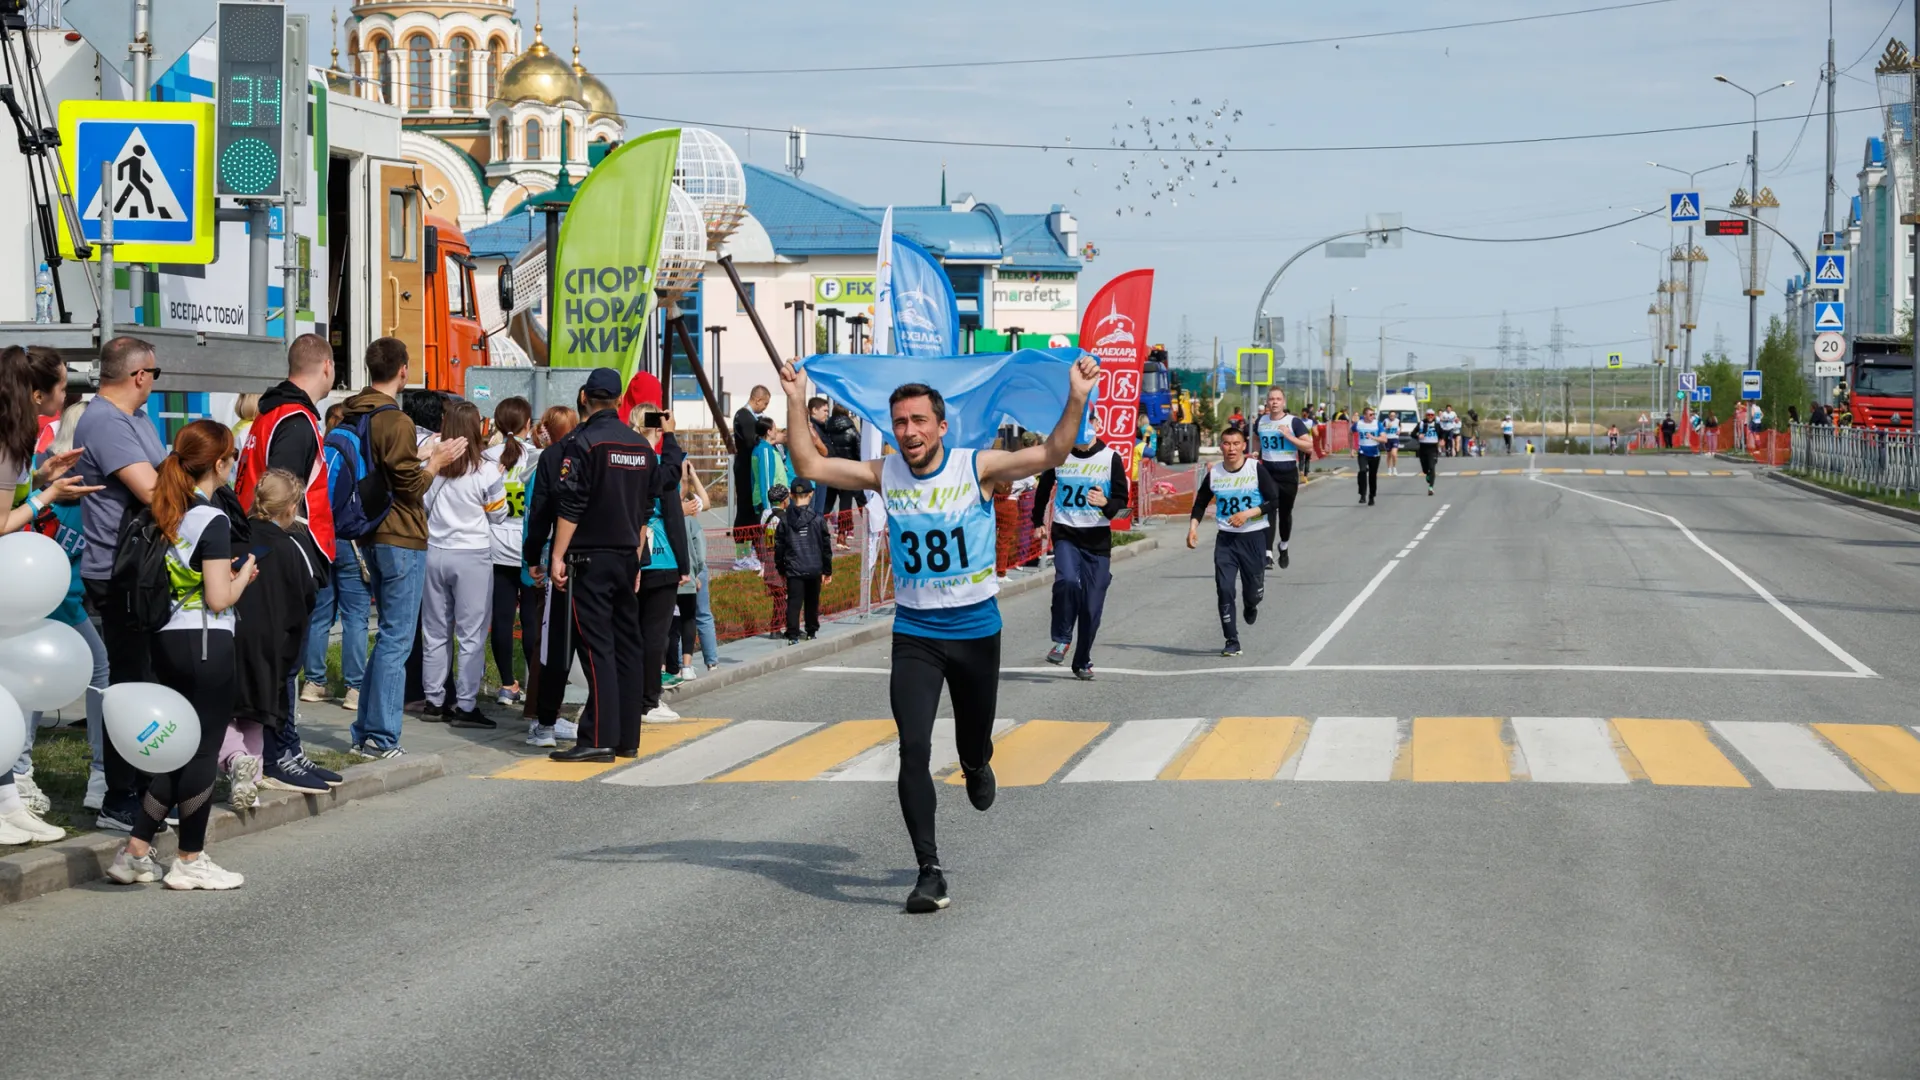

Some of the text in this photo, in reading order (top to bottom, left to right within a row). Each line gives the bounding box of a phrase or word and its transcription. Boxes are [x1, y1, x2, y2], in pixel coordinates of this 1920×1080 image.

[231, 76, 280, 126] 34
[170, 301, 245, 326] ВСЕГДА С ТОБОЙ
[1091, 347, 1137, 358] САЛЕХАРД
[1821, 341, 1839, 353] 20
[1261, 436, 1285, 450] 331
[610, 453, 646, 467] ПОЛИЦИЯ
[1062, 485, 1099, 508] 26
[1219, 496, 1253, 516] 283
[900, 526, 970, 575] 381
[932, 576, 971, 589] ЯМАЛ
[139, 720, 177, 757] ЯМАЛ
